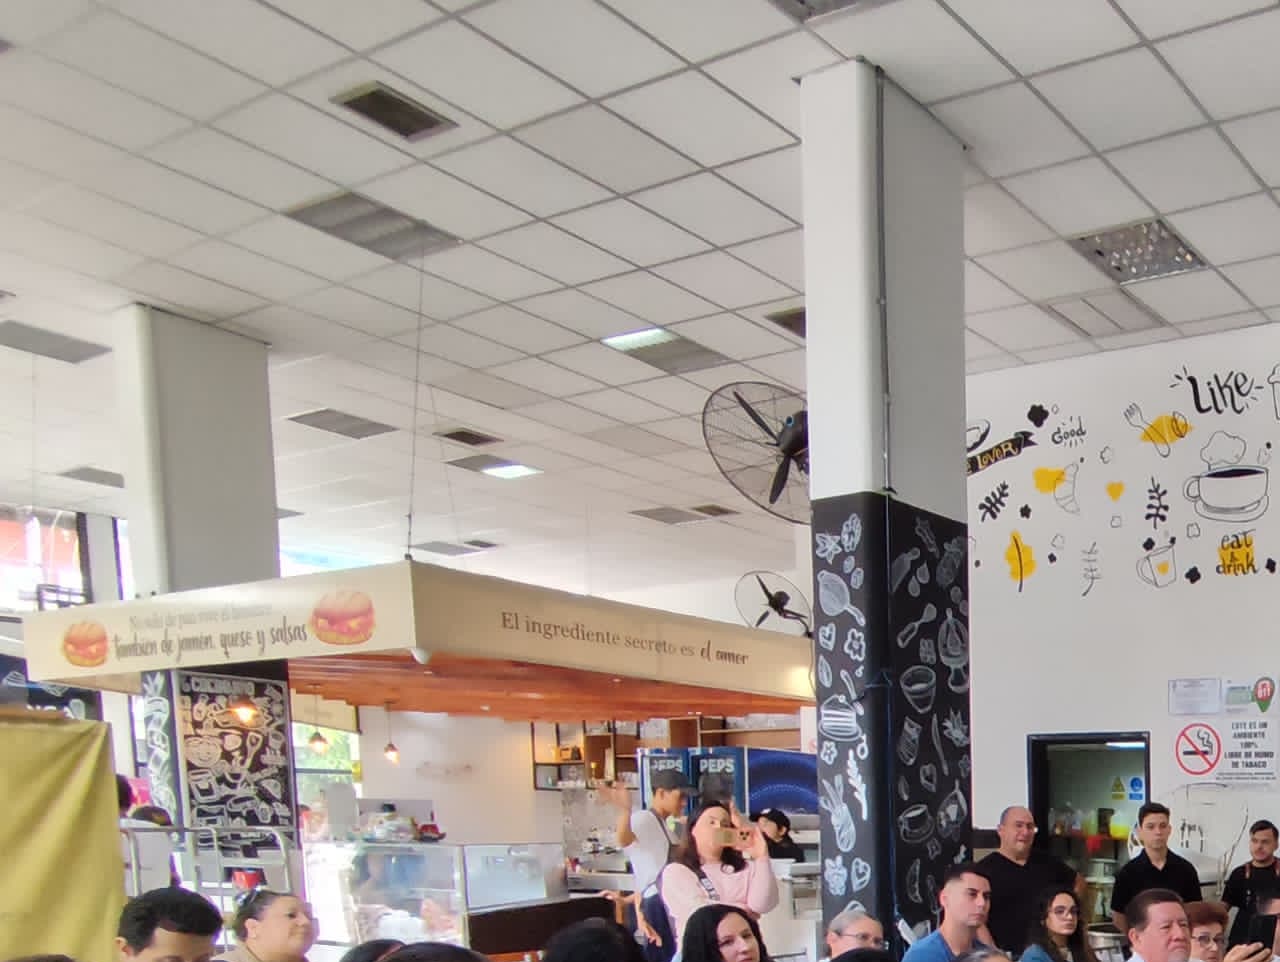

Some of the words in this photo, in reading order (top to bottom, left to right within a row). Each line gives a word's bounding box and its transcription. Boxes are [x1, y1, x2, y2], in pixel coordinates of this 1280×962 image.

[1220, 529, 1256, 550] eat
[1216, 550, 1258, 576] drink
[256, 630, 265, 655] y
[270, 616, 308, 645] salsas
[501, 611, 520, 630] El
[525, 616, 620, 646] ingrediente
[623, 634, 676, 654] secreto
[680, 644, 695, 656] es
[716, 649, 749, 665] amor
[1231, 761, 1239, 769] DE
